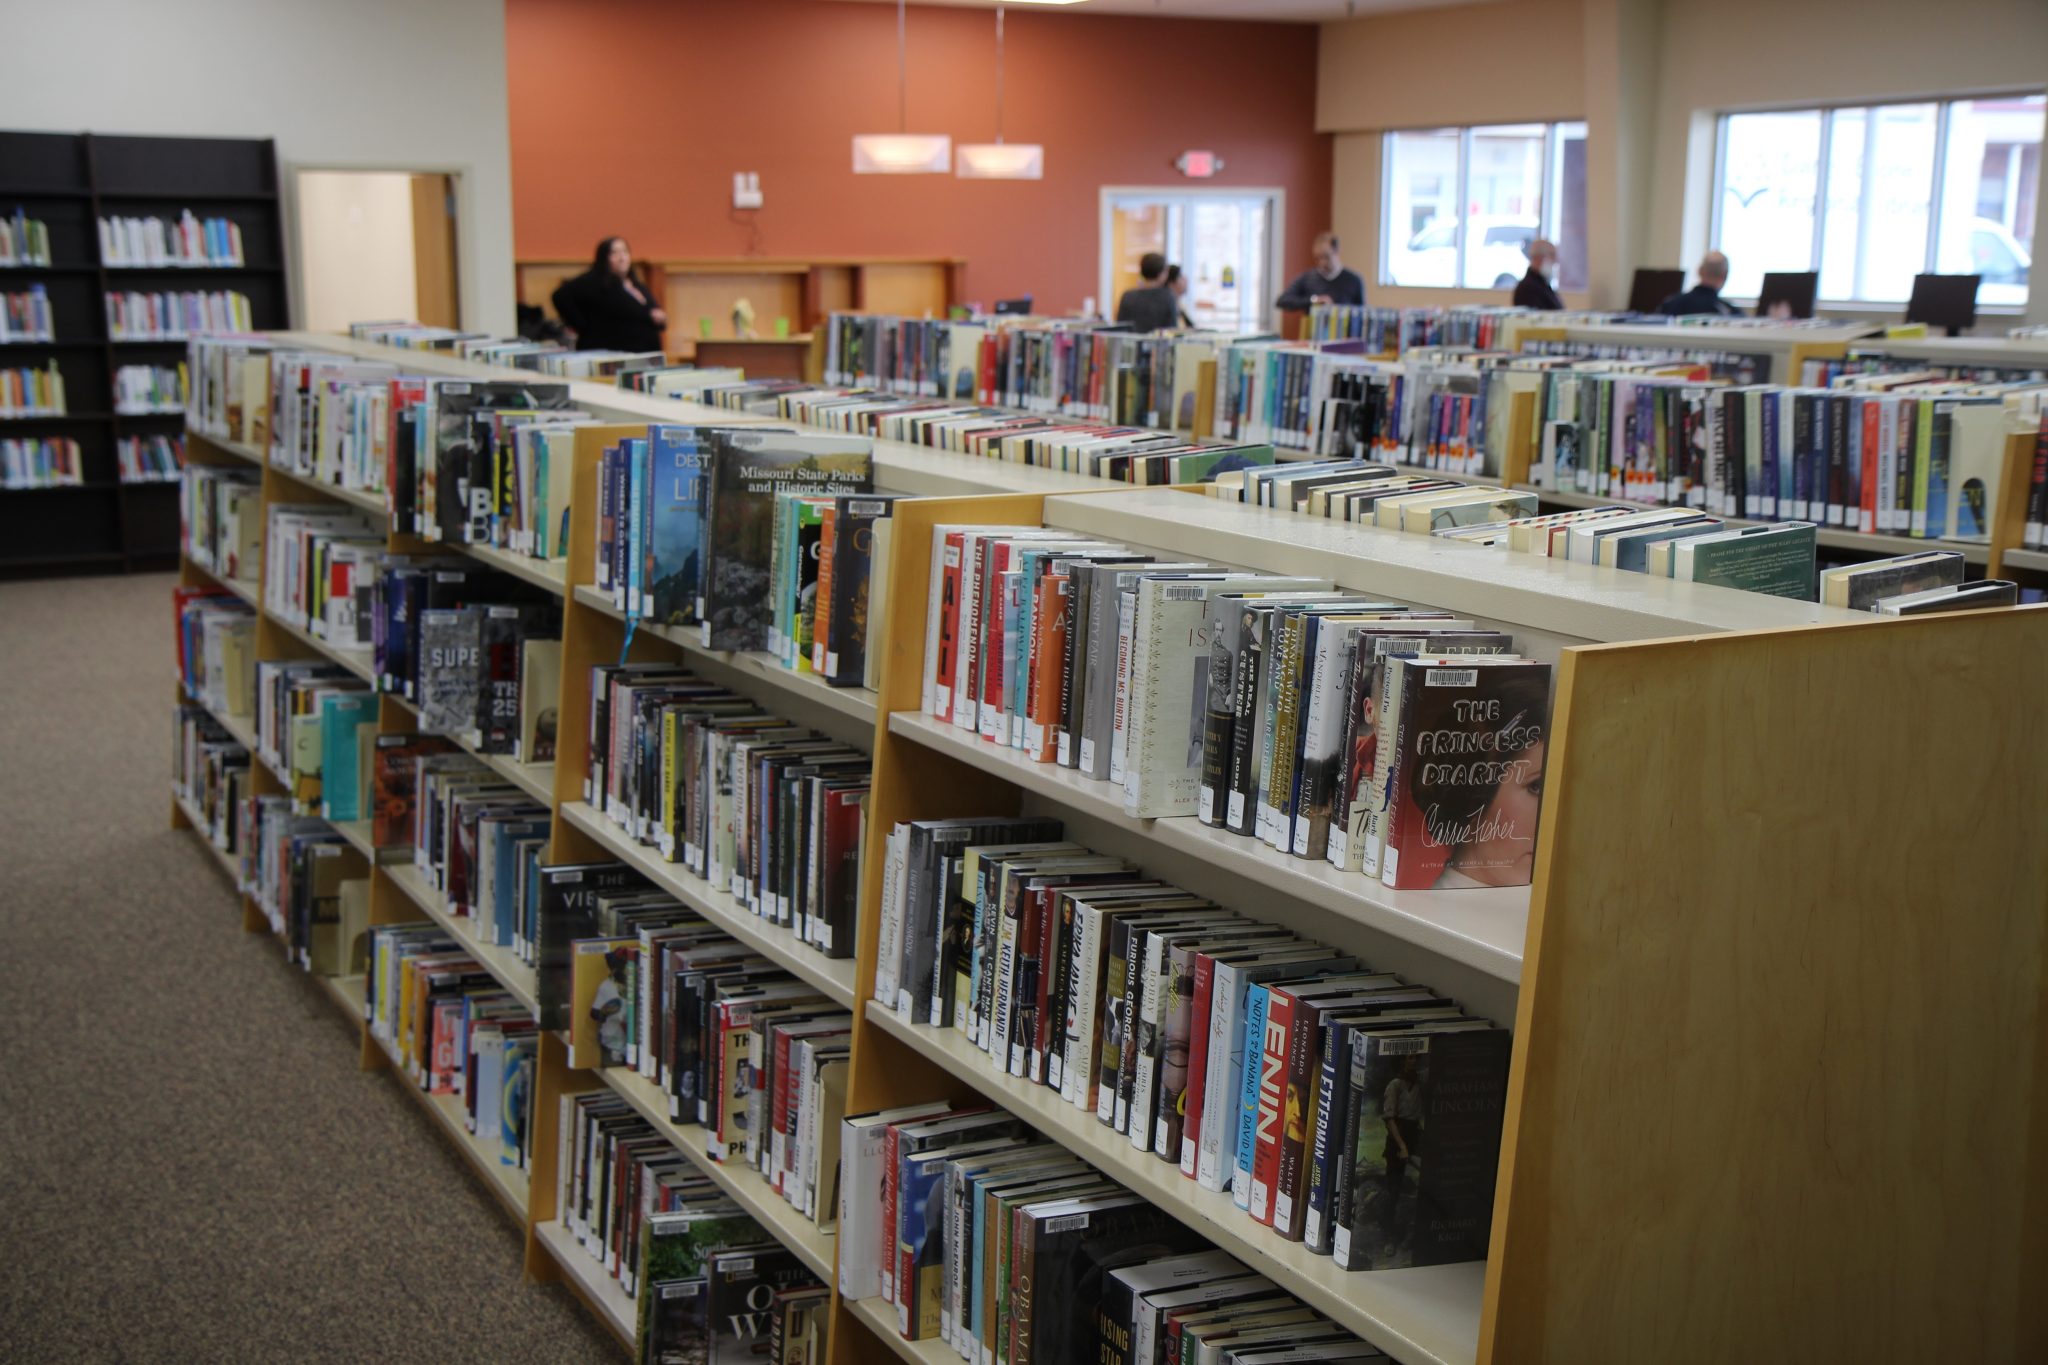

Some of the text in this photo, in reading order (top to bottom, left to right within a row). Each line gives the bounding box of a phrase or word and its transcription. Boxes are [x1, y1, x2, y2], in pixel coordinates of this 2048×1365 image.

[675, 453, 711, 468] DEST
[1714, 407, 1725, 482] MISCHLING
[740, 466, 866, 482] Missouri State Parks
[748, 482, 856, 495] and Historic Sites
[619, 515, 624, 525] TO
[796, 545, 804, 599] Genealogy
[974, 544, 982, 568] THE
[941, 575, 954, 676] ALI
[969, 573, 981, 662] PHENOMENON
[1018, 600, 1028, 662] BALDWIN
[1029, 594, 1039, 660] BANNON
[1089, 588, 1102, 666] VANITY FAIR
[432, 648, 480, 667] SUPE
[1036, 635, 1044, 667] Option
[1061, 585, 1075, 714] ELIZABETH BISHOP
[1274, 628, 1284, 690] LOVE AND
[1276, 627, 1290, 711] DIMAGGIO
[1287, 629, 1297, 675] DINNER
[493, 682, 518, 697] TH
[1115, 635, 1128, 731] BECOMING MS. BURTON
[1235, 650, 1247, 718] CUSTER
[1284, 681, 1293, 713] WITH
[1314, 647, 1327, 707] MANDERLEY
[1384, 667, 1393, 698] Pretend
[493, 700, 518, 716] 25
[1244, 684, 1254, 716] REAL
[1265, 703, 1274, 738] CLAIRE
[1454, 699, 1500, 722] THE
[1417, 726, 1540, 755] PRINCESS
[736, 749, 745, 814] DEVOTION
[1422, 760, 1531, 785] DIARIST
[1422, 802, 1530, 847] Carrie Fisher
[599, 874, 625, 885] THE
[890, 858, 904, 913] Dangerous
[905, 870, 918, 956] LIGHTER SHADOW
[989, 903, 997, 935] KEVIN
[1088, 915, 1096, 933] THE
[888, 916, 898, 957] Woman
[1085, 936, 1093, 980] SECRETS
[984, 962, 993, 993] CAN'T
[995, 921, 1013, 1039] I'M KEITH HERNANDE
[1069, 912, 1084, 1016] ERIKA JAYNE
[1056, 942, 1067, 1033] AMERICAN LION
[1082, 1002, 1090, 1014] MY
[1085, 984, 1092, 998] OF
[1122, 936, 1138, 1041] FURIOUS GEORGE
[1147, 969, 1157, 1014] BOBBY
[733, 1033, 750, 1047] TH
[1294, 1019, 1300, 1033] DA
[1298, 1019, 1309, 1075] LEONARDO
[1140, 1065, 1148, 1094] CHRIS
[1255, 987, 1289, 1144] LENIN
[1314, 1061, 1336, 1160] LETTERMAN
[1431, 1097, 1499, 1116] LINCOLN
[1433, 1081, 1499, 1096] ABRAHAM
[1345, 1091, 1357, 1141] BECOMING
[728, 1142, 750, 1156] PH
[1239, 1114, 1252, 1170] DAVID LE
[884, 1135, 895, 1216] Priestdaddy
[1286, 1156, 1295, 1196] WALTER
[1313, 1164, 1321, 1187] JASON
[1342, 1142, 1353, 1187] ABRAHAM
[952, 1240, 960, 1288] McENROE
[1017, 1275, 1031, 1363] OBAMA
